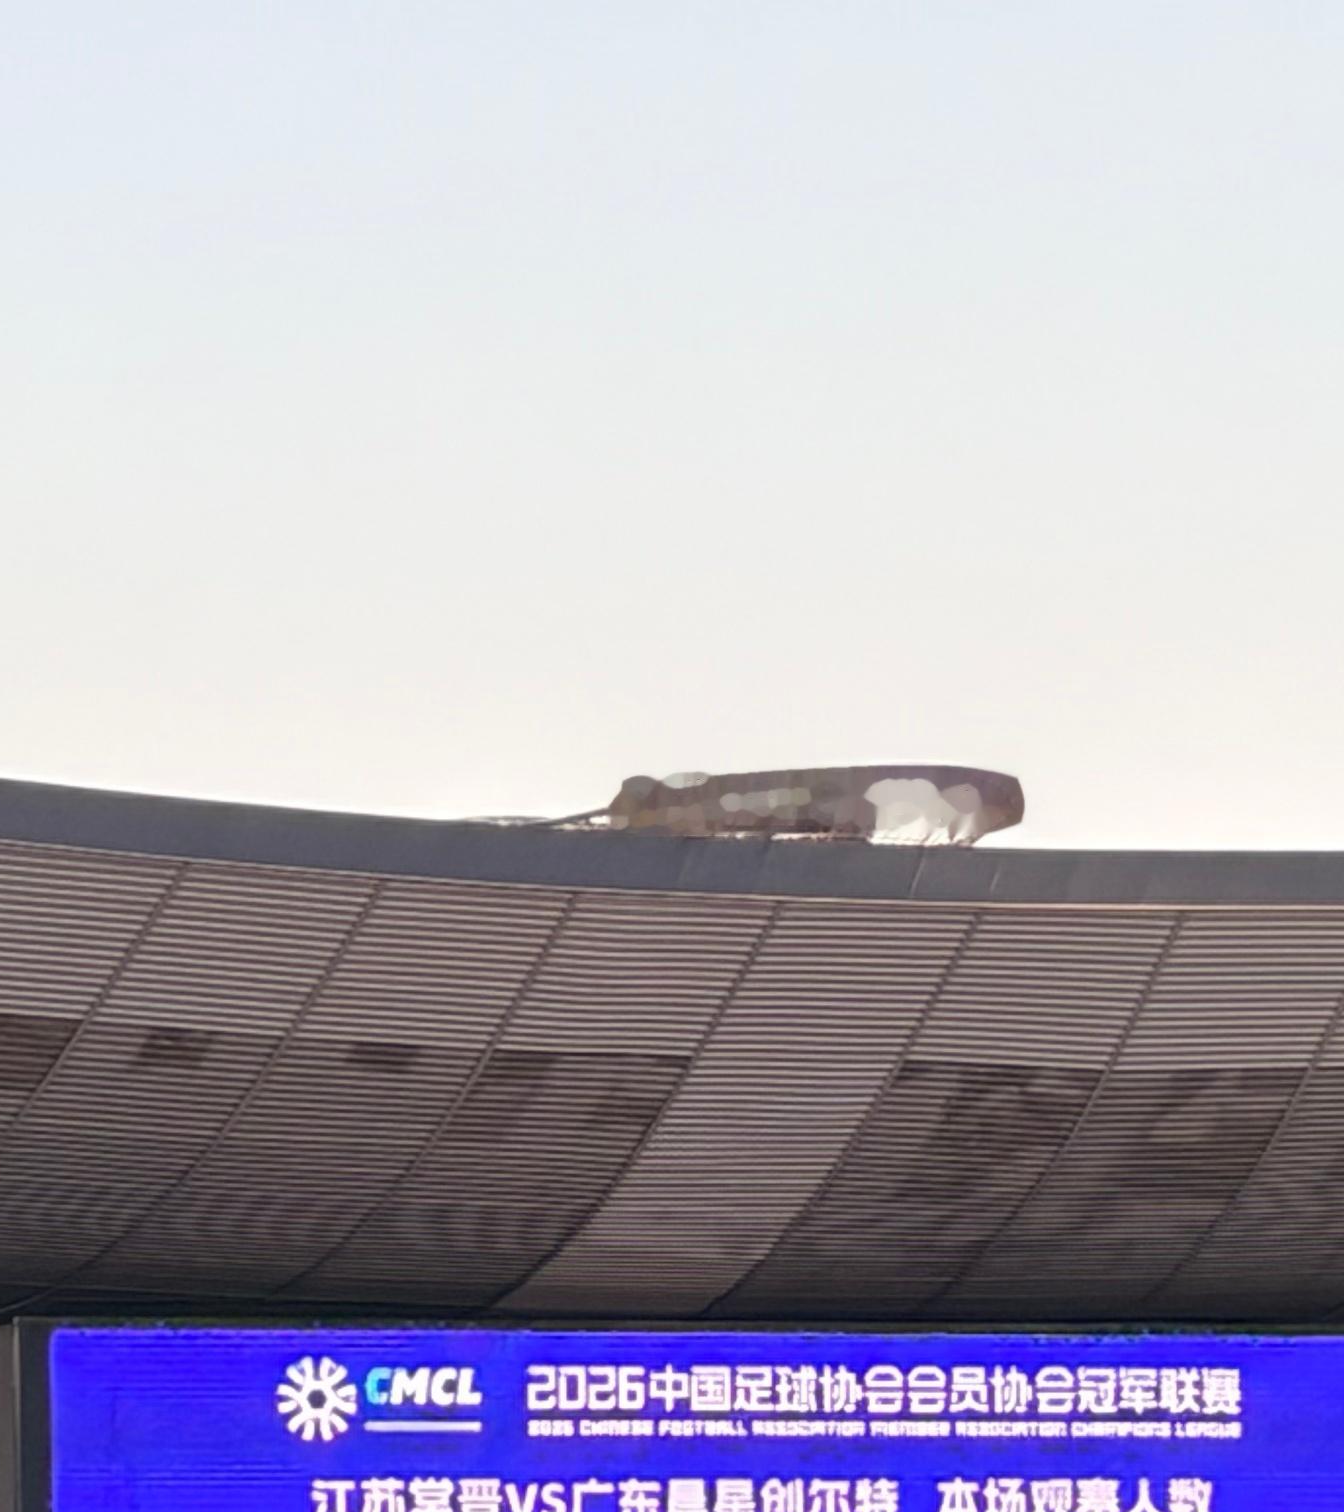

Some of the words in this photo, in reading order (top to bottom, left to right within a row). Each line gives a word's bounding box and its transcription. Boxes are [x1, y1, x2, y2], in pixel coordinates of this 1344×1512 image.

[364, 1366, 483, 1406] CMCL
[526, 1363, 1242, 1414] 2026中国足球协会会员协会冠军联赛
